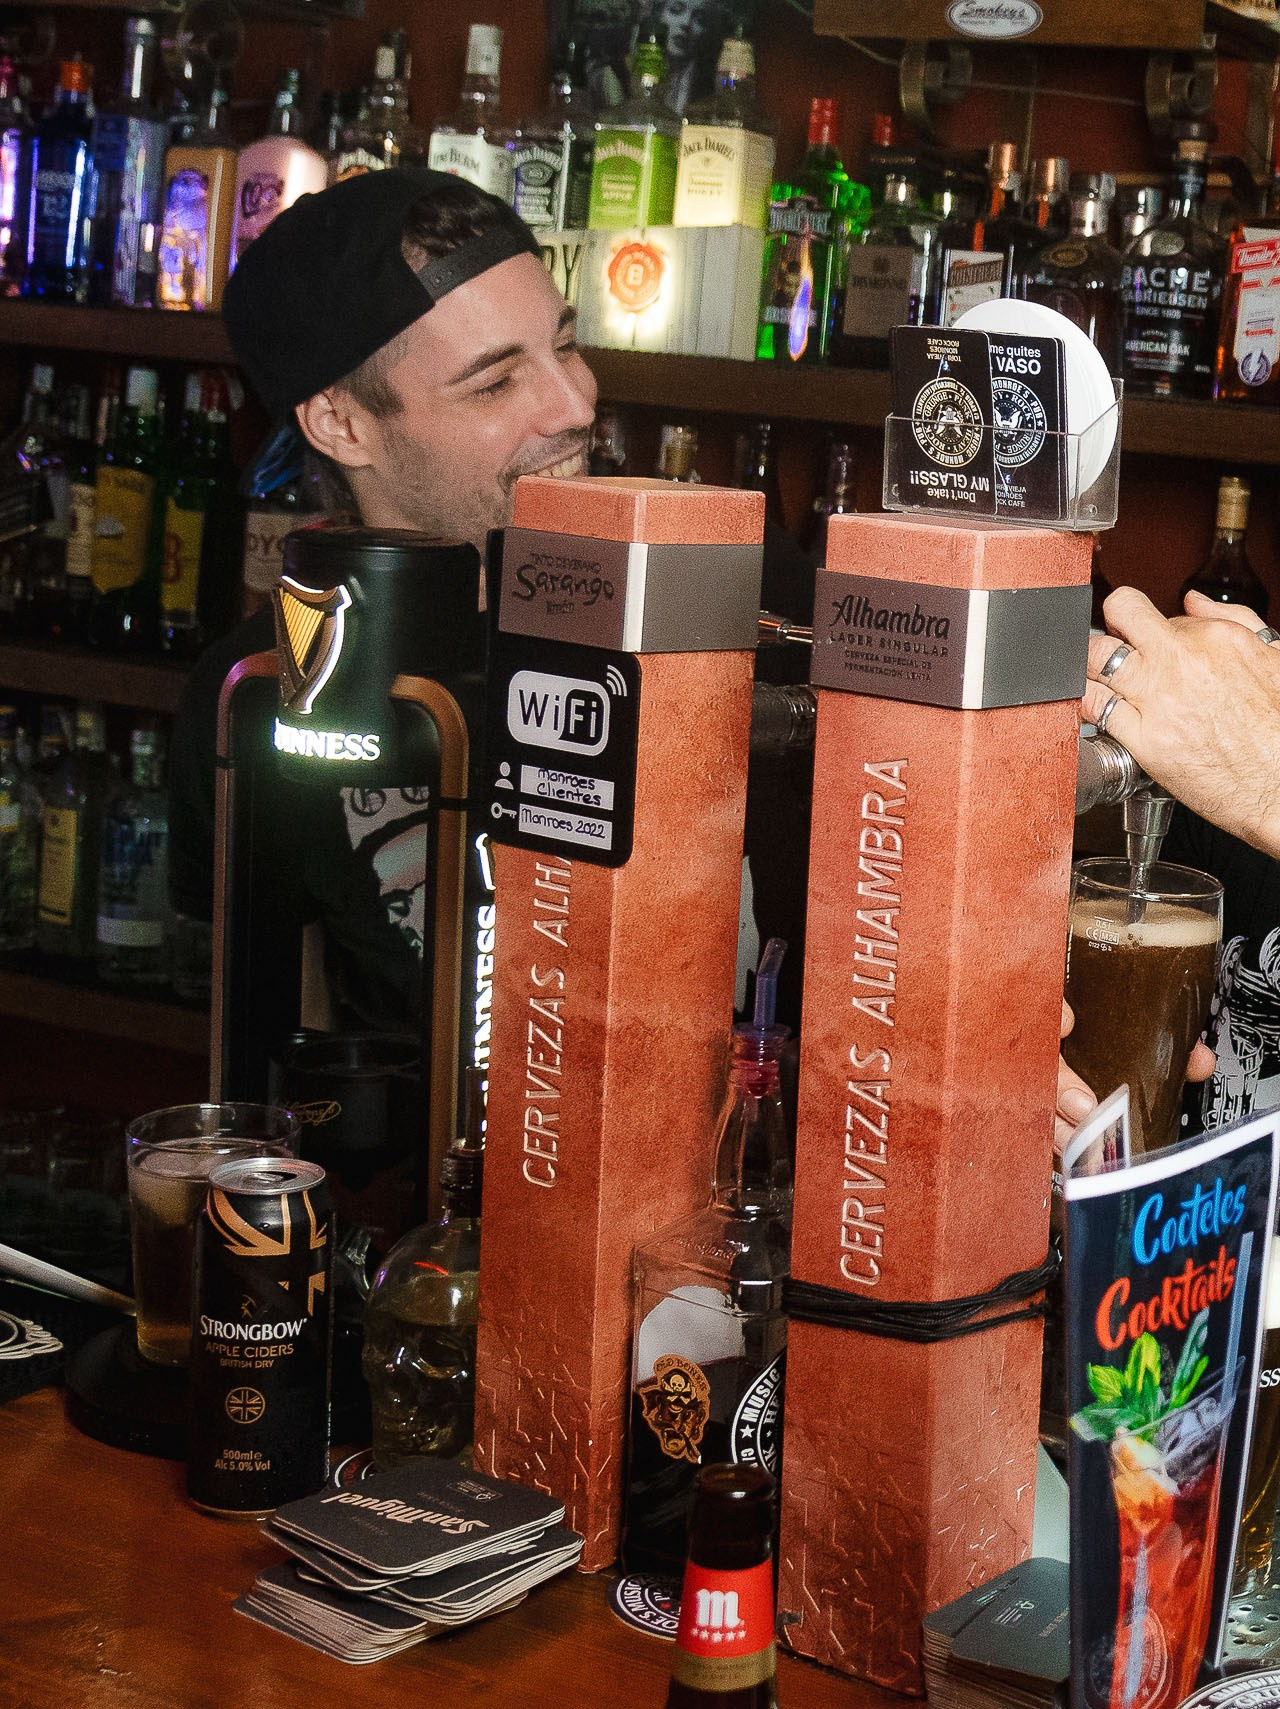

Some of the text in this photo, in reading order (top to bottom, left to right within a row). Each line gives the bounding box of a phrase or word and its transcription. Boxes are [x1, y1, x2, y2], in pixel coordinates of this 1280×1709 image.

[940, 338, 960, 348] ROCK
[1006, 345, 1042, 359] quites
[996, 357, 1042, 376] VASO
[909, 470, 990, 492] MY GLASS!!
[927, 487, 976, 503] Don't take
[1007, 500, 1027, 508] CAFE
[829, 593, 951, 641] Alhambra
[830, 630, 950, 658] LAGER SINGULAR
[844, 649, 932, 670] CERVEZA ESPECIAL DE
[518, 687, 598, 739] WiFi
[536, 782, 602, 806] Clientes
[575, 820, 606, 839] 2022
[838, 757, 911, 1287] CERVEZAS ALHAMBRA
[522, 962, 567, 1189] CERVEZAS
[1131, 1176, 1247, 1266] Cocteles
[1095, 1244, 1238, 1352] Cocktails
[200, 1314, 304, 1341] STRONGBOW
[205, 1341, 294, 1359] APPLE CIDERS
[219, 1357, 275, 1370] BRITISH DRY
[743, 1367, 782, 1424] MUSIC
[214, 1459, 271, 1472] Alc 5.0% Vol
